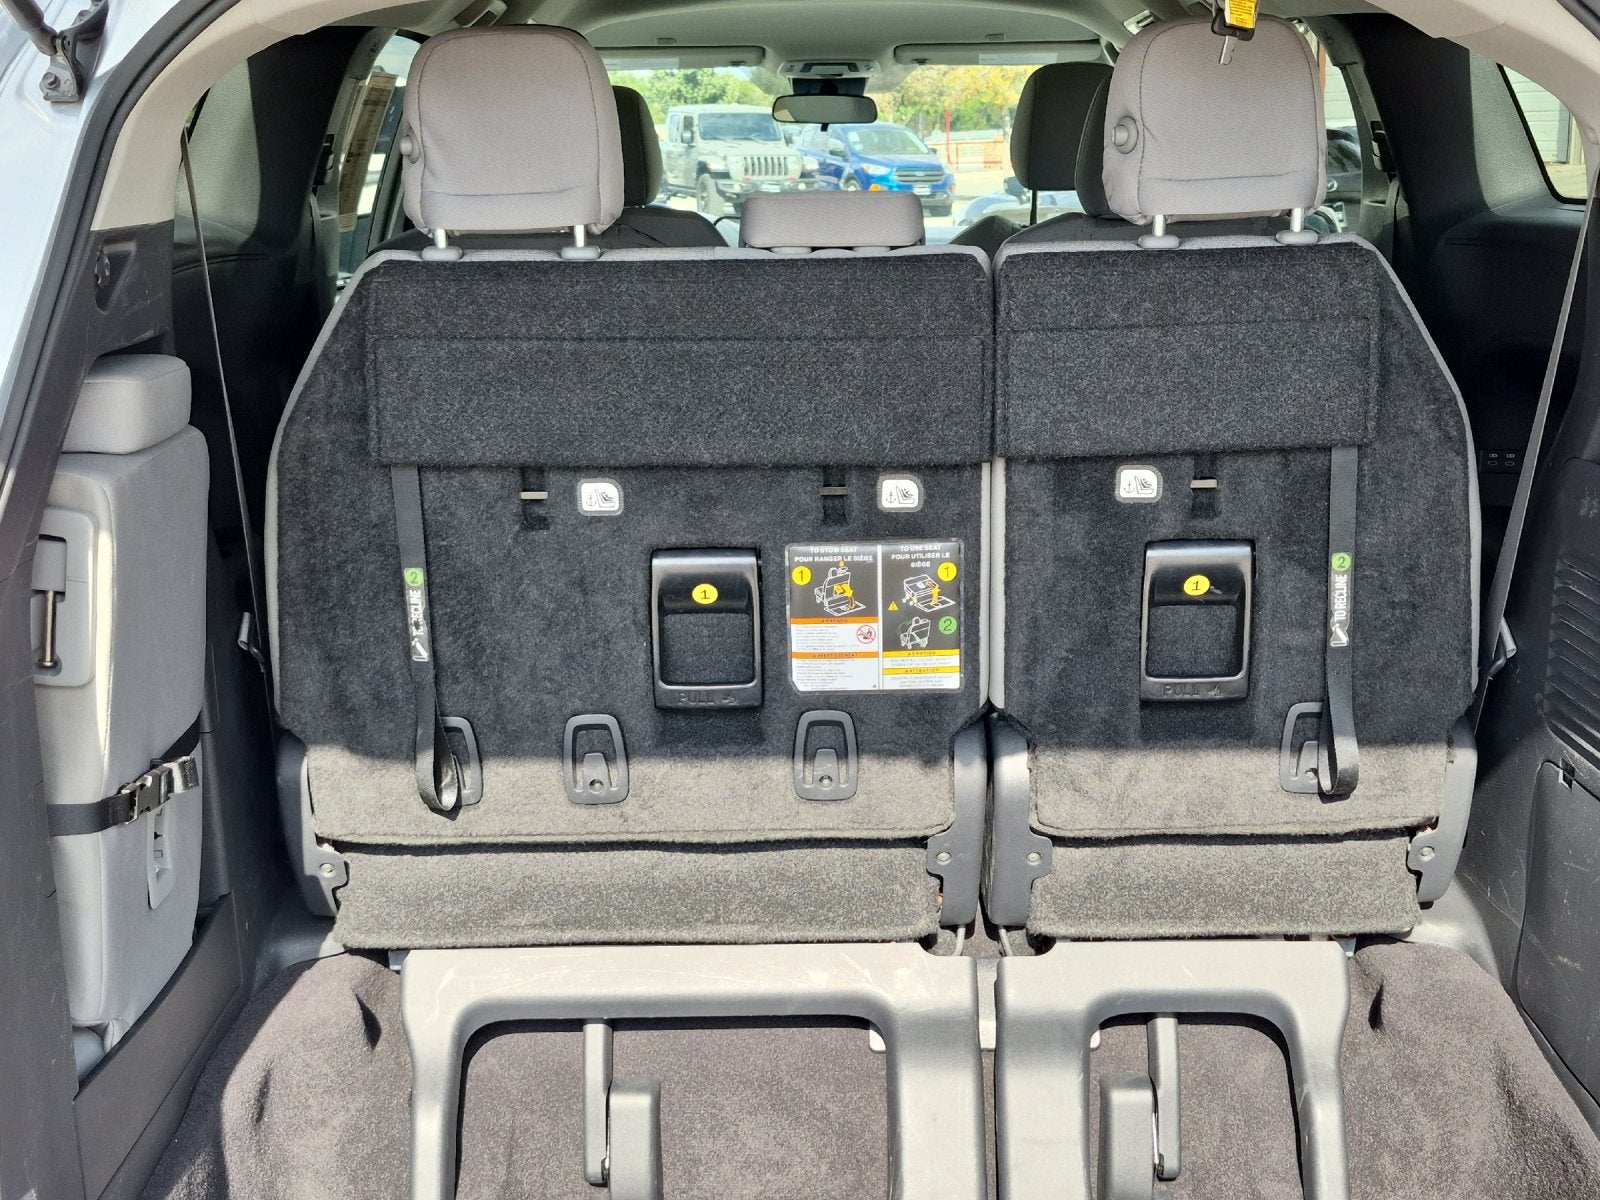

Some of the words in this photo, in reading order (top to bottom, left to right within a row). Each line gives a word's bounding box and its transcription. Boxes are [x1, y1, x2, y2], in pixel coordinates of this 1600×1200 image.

[1337, 556, 1346, 569] 2
[409, 571, 419, 584] 2
[1334, 574, 1348, 610] RECLINE
[1334, 610, 1347, 622] TO
[943, 618, 953, 631] 2
[1163, 684, 1200, 698] PULL
[678, 691, 715, 705] PULL
